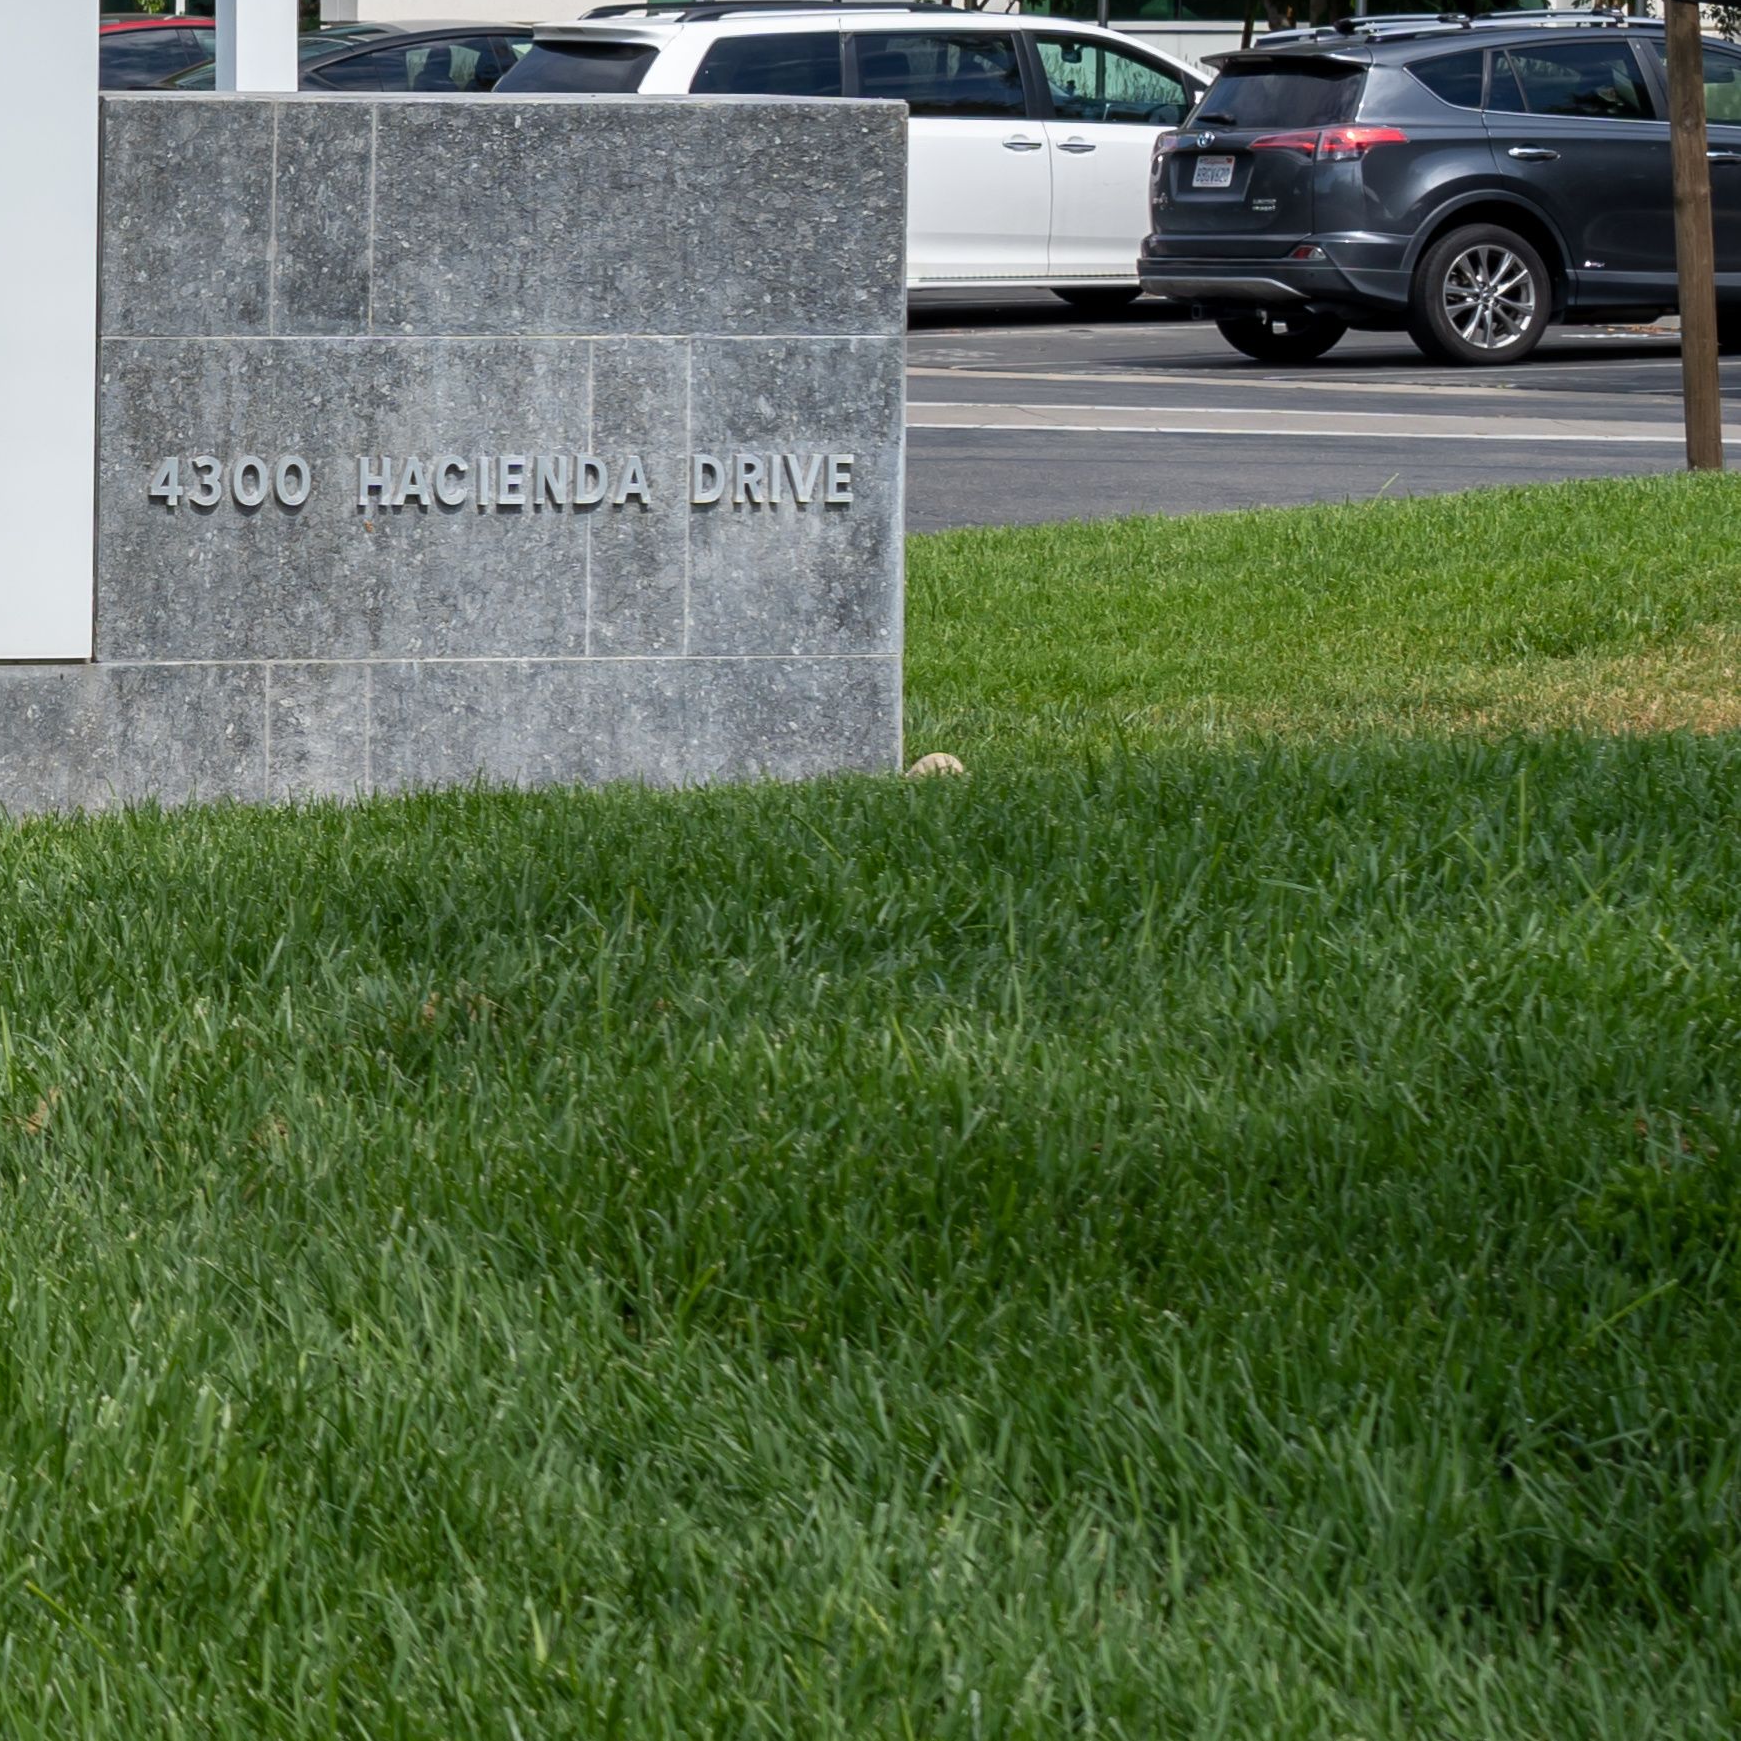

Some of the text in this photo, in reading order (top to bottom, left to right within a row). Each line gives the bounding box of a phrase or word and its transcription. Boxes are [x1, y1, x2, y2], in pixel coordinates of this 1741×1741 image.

[148, 453, 855, 507] 4300 HACIENDA DRIVE
